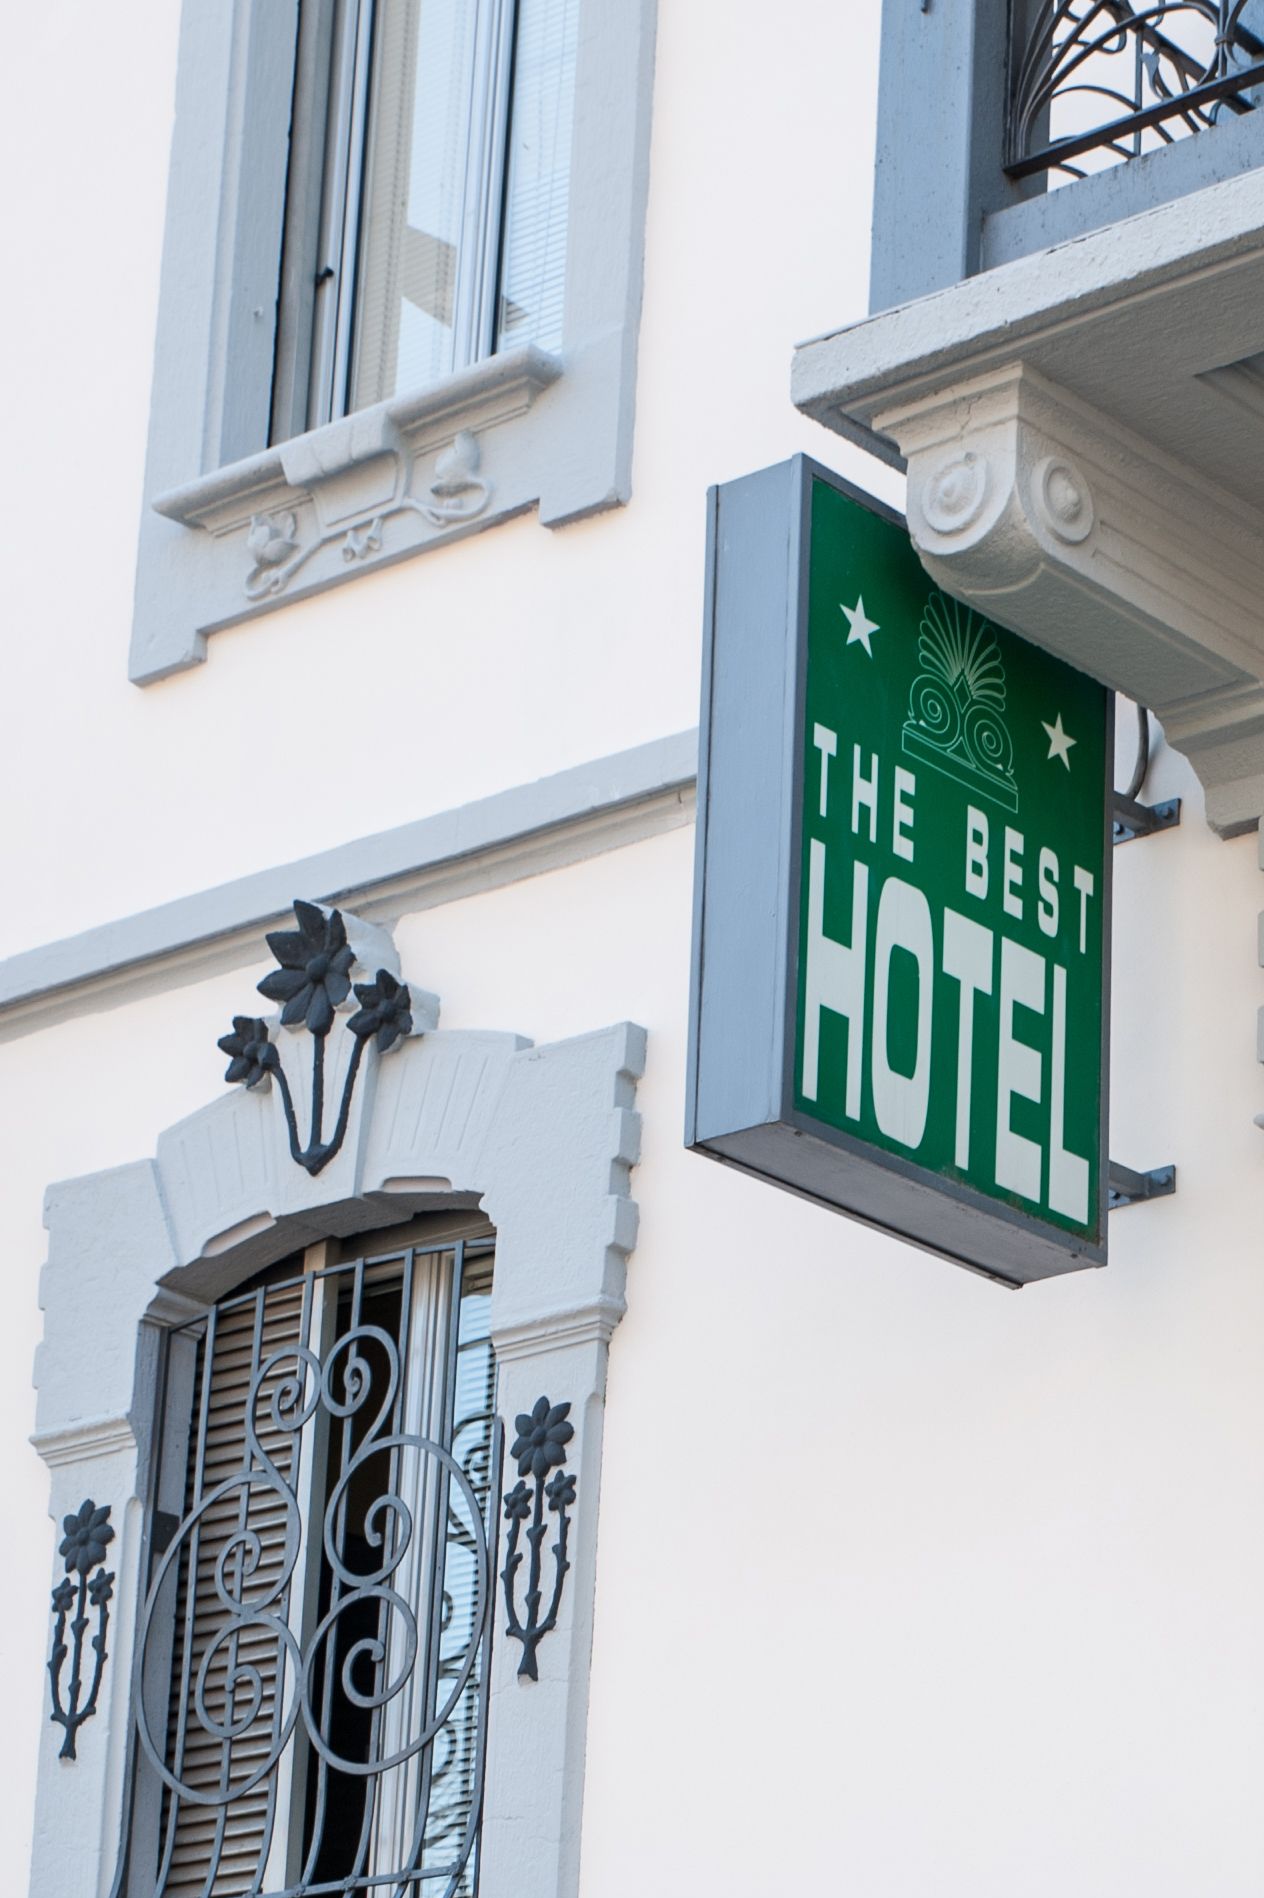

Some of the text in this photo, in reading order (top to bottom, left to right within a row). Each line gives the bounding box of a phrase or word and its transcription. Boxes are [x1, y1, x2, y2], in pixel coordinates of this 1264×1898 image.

[814, 722, 1094, 953] THE BEST
[802, 838, 1091, 1225] HOTEL
